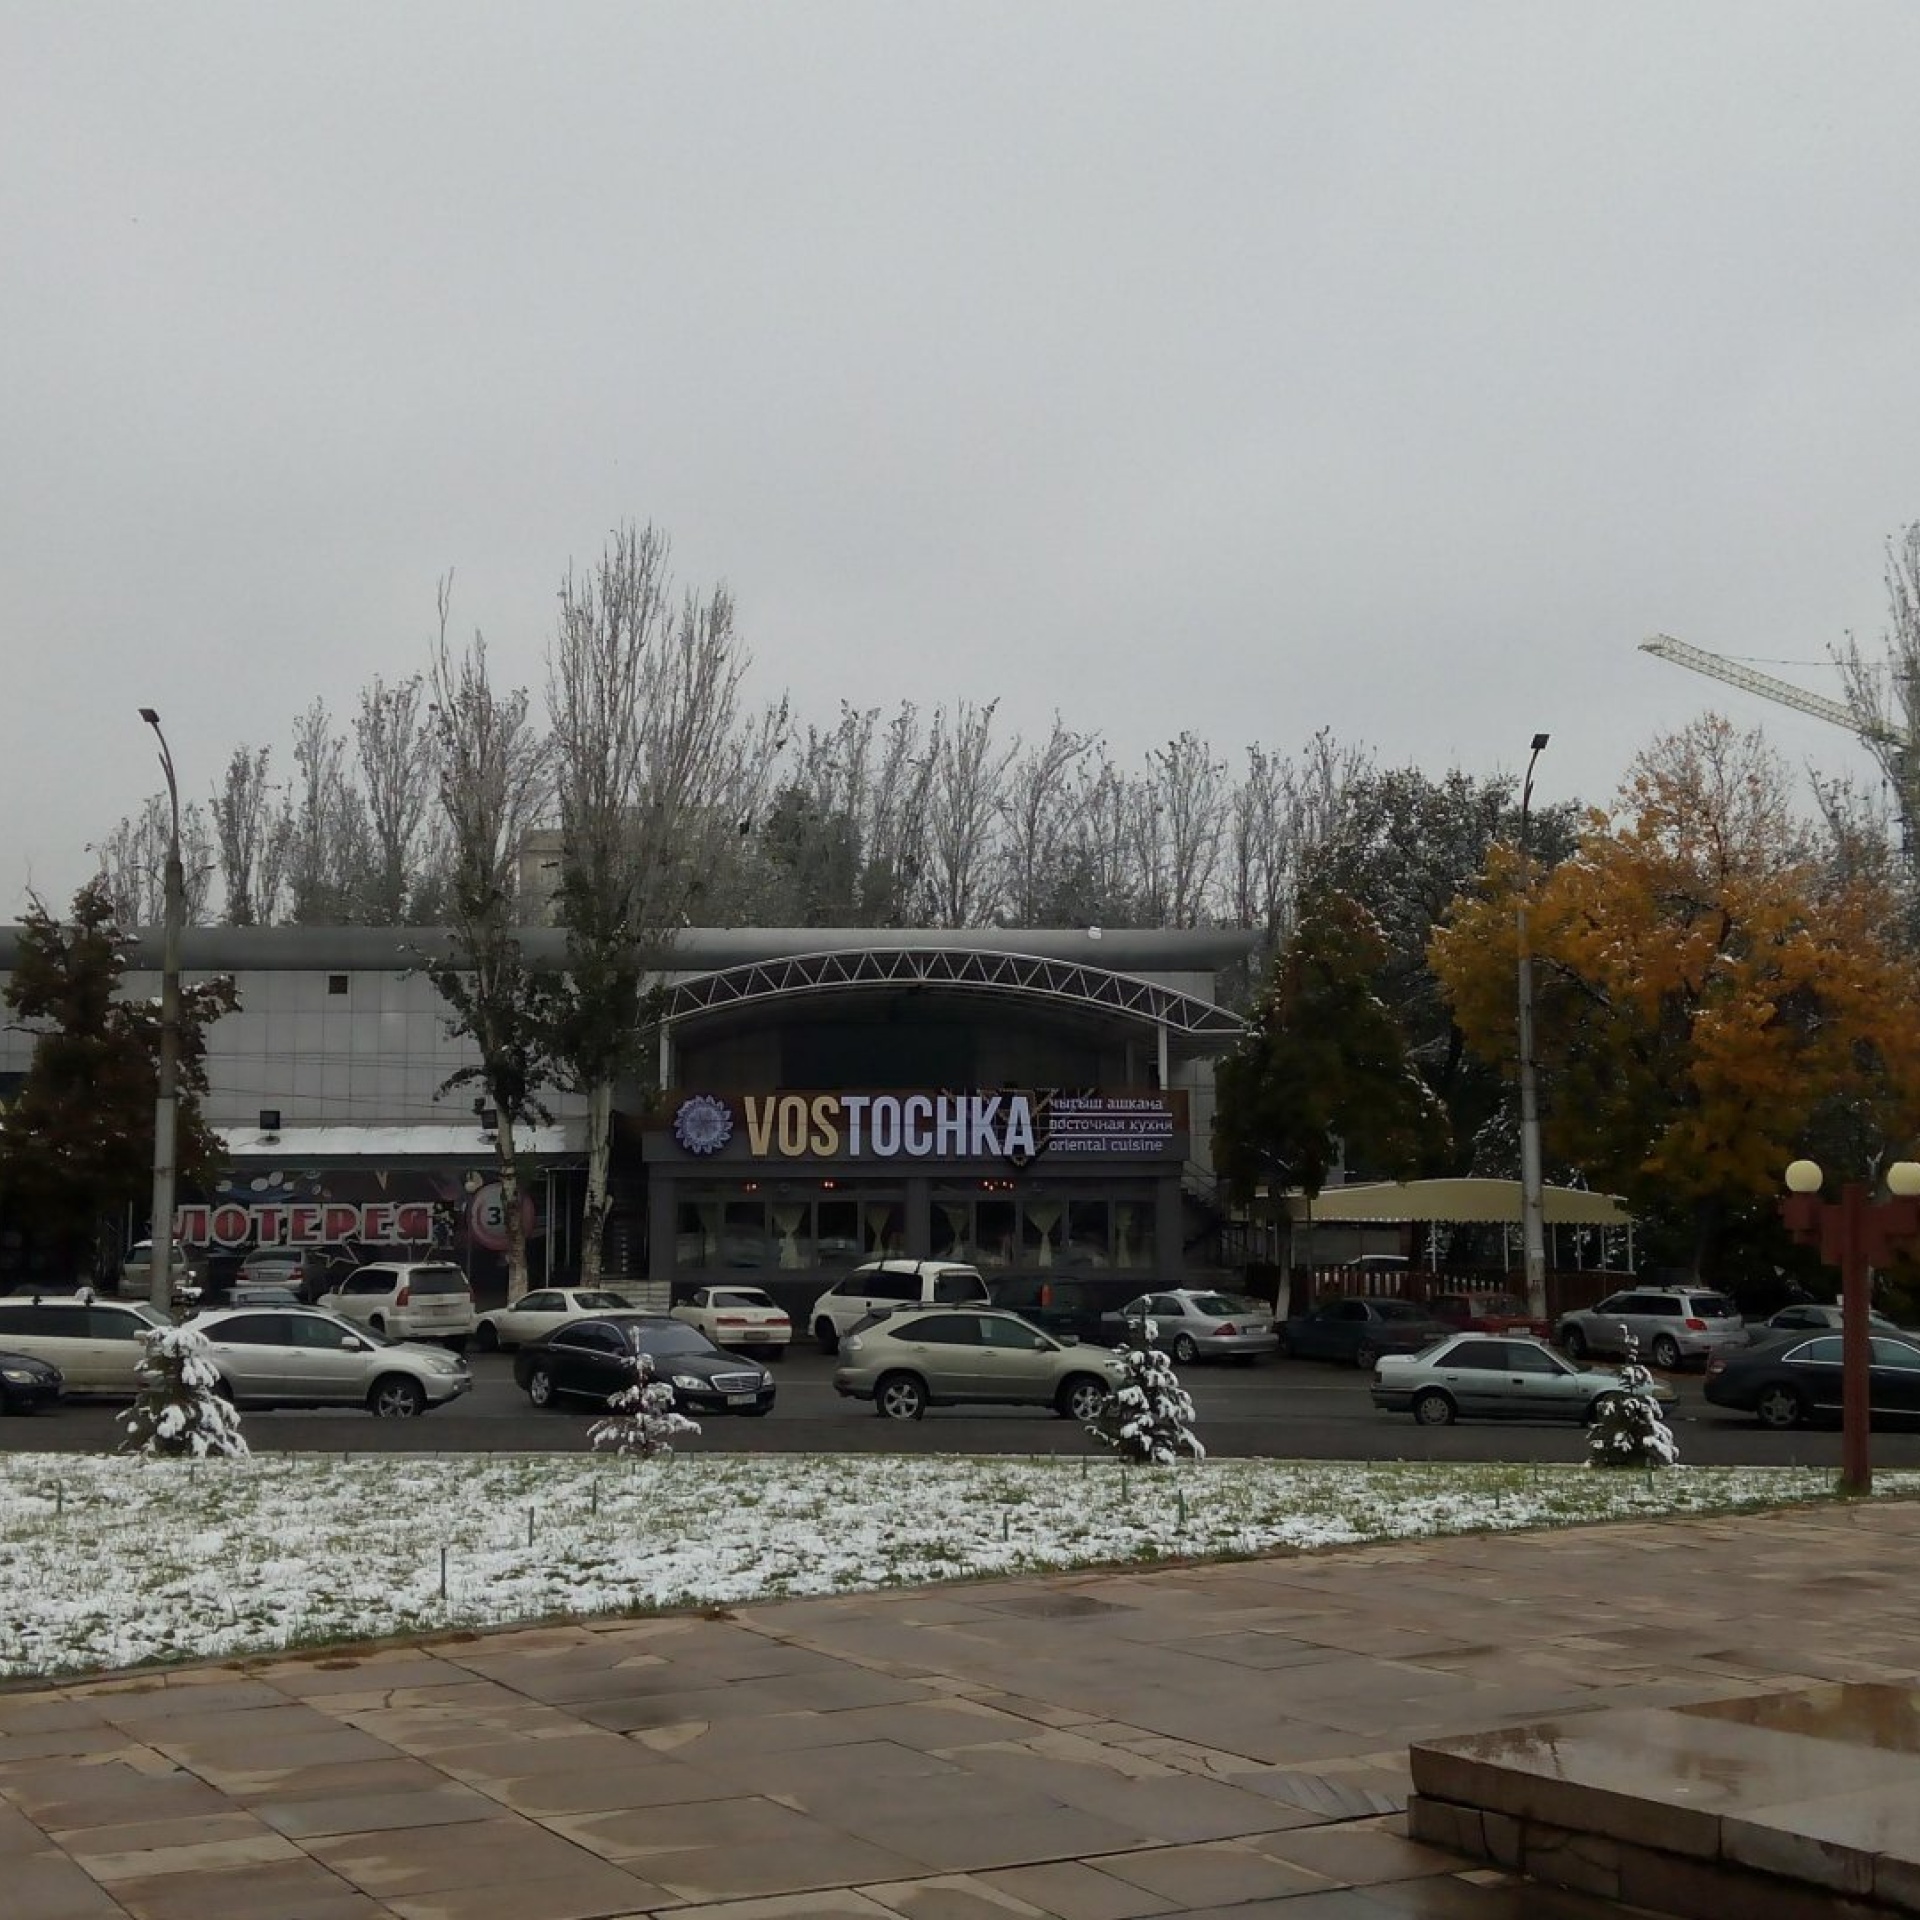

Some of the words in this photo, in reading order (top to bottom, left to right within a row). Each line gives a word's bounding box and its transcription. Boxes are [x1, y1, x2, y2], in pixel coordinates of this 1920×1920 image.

[744, 1095, 1035, 1157] VOSTOCHKA
[1049, 1119, 1125, 1130] восточная
[1049, 1137, 1107, 1151] oriental
[1111, 1138, 1163, 1151] cuisine
[172, 1201, 434, 1247] ЛОТЕРЕЯ
